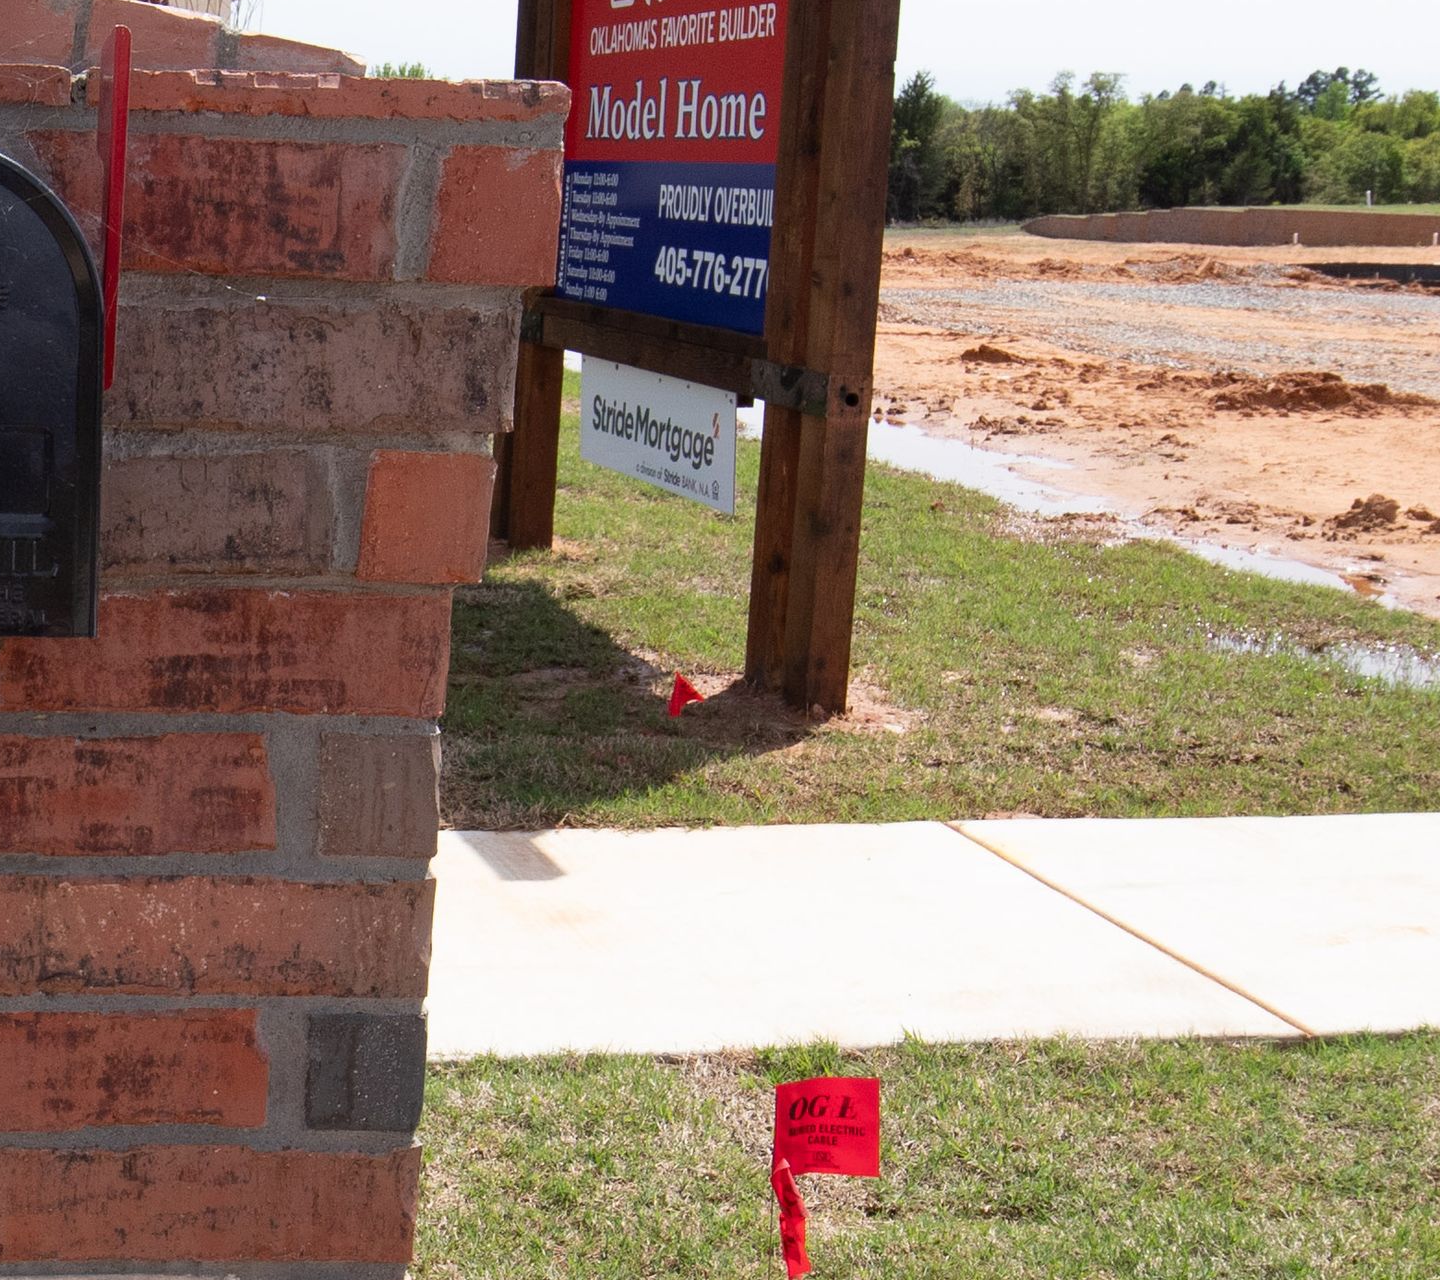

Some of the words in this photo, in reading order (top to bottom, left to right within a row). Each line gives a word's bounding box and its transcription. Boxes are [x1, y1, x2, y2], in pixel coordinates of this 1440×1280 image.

[590, 18, 658, 56] OKLAHOMA'S
[660, 11, 716, 48] FAVORITE
[719, 2, 777, 42] BUILDER
[585, 76, 669, 141] Model
[674, 78, 767, 141] Home
[573, 172, 593, 188] Monday
[572, 190, 592, 207] Tuesday
[658, 184, 713, 222] PROUDLY
[714, 187, 774, 227] OVERBUIL
[654, 245, 769, 299] 405-776-277
[664, 468, 680, 486] Stride
[820, 1124, 866, 1136] ELECTRIC
[807, 1135, 838, 1146] CABLE
